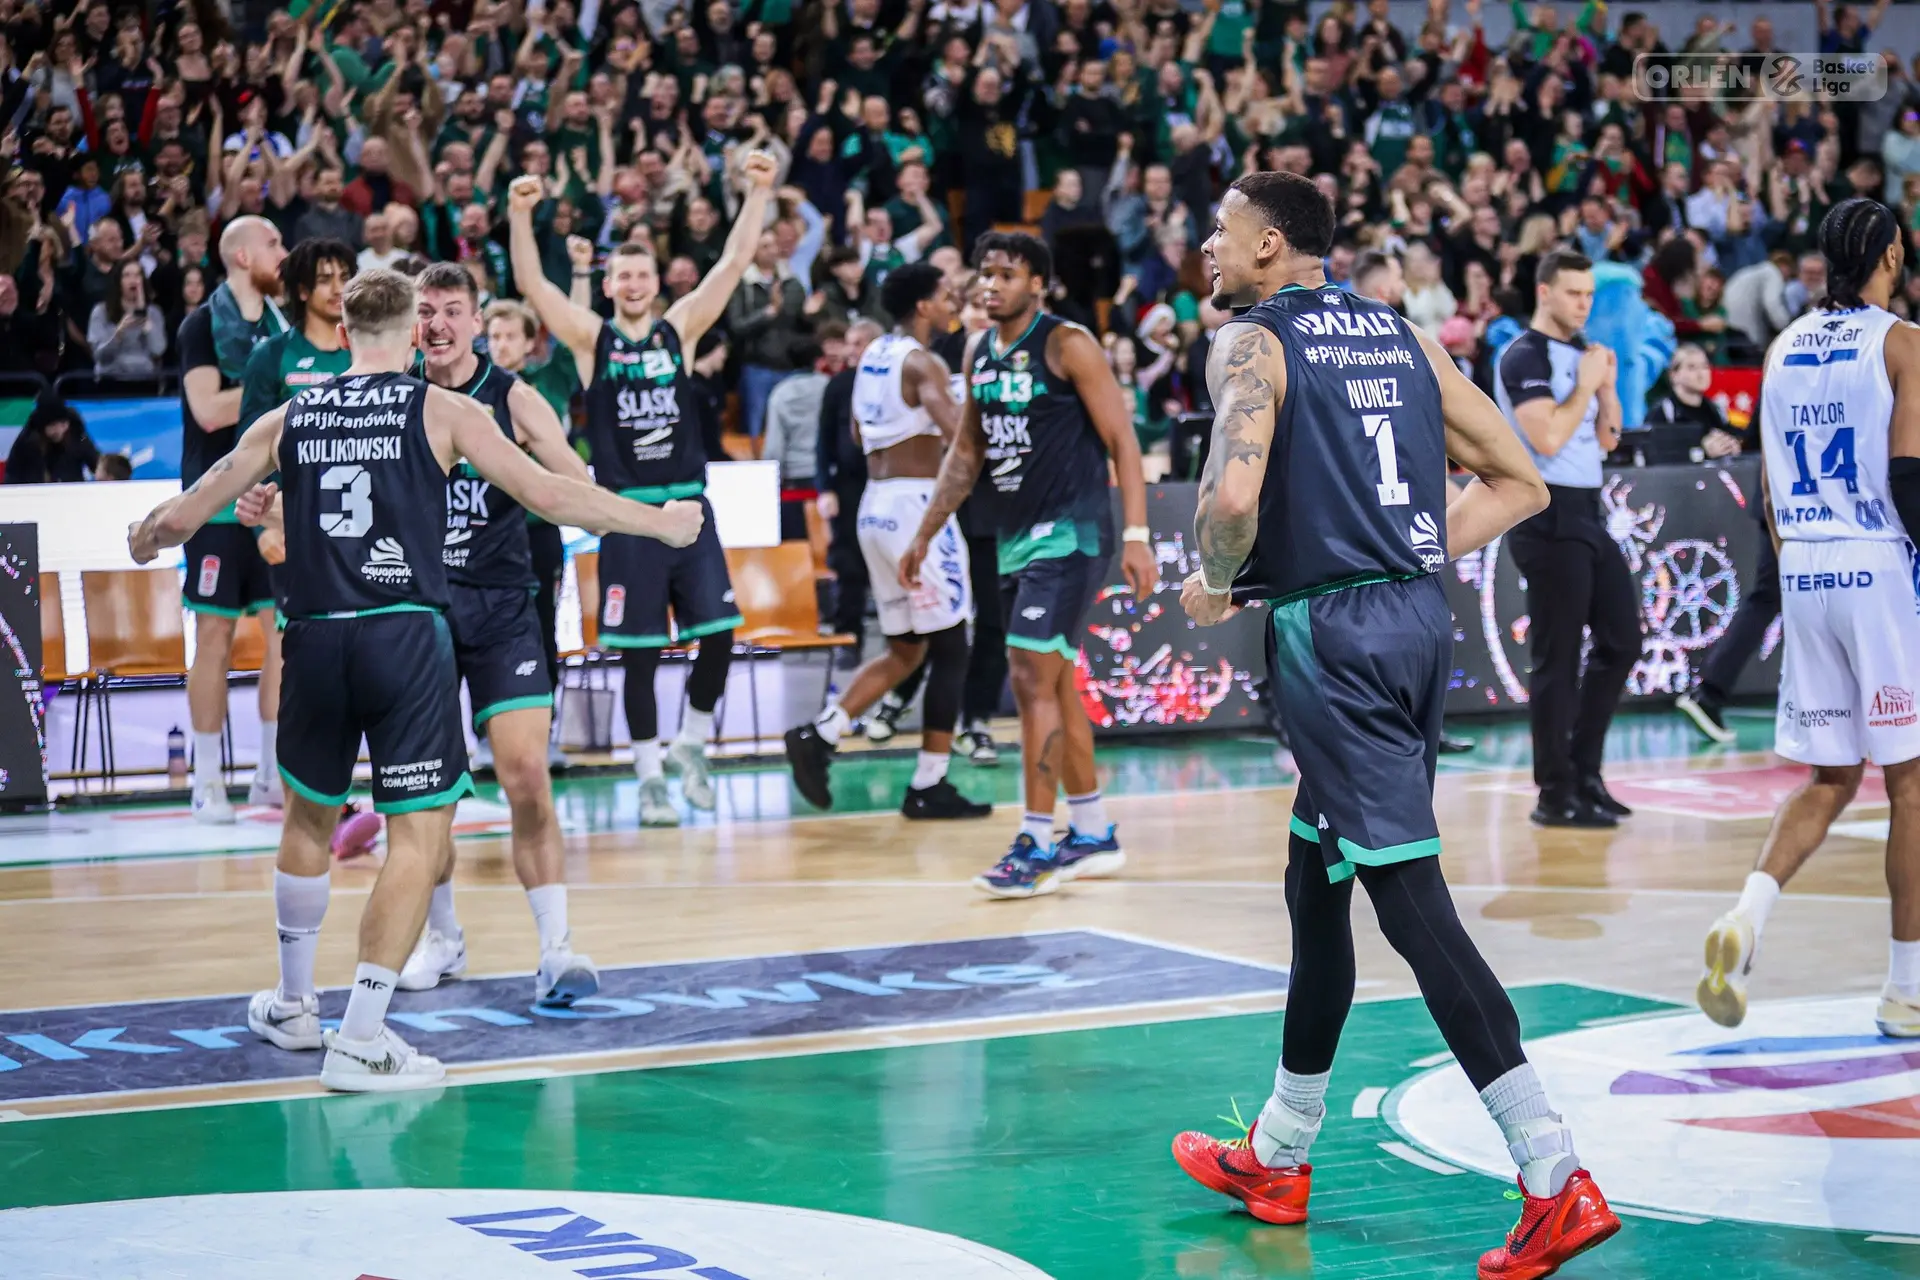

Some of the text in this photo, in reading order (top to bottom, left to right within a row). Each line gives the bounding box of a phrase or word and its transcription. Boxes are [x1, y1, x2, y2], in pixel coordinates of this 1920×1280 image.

[1292, 312, 1400, 337] BAZALT
[1822, 320, 1846, 333] 4F
[641, 348, 677, 379] 21
[1304, 345, 1415, 370] #PijKranówkę
[343, 375, 371, 390] 4F
[999, 370, 1033, 403] 13
[1345, 378, 1404, 409] NUNEZ
[297, 385, 415, 408] BAZALT
[291, 410, 407, 430] #PijKranówkę
[1791, 402, 1845, 427] TAYLOR
[297, 436, 402, 465] KULIKOWSKI
[1361, 413, 1411, 507] 1
[1784, 426, 1860, 496] 14
[319, 463, 374, 538] 3
[360, 565, 413, 579] aquapark
[1782, 571, 1874, 592] TERBUD
[382, 773, 428, 788] COMARCH
[358, 977, 389, 991] 4F
